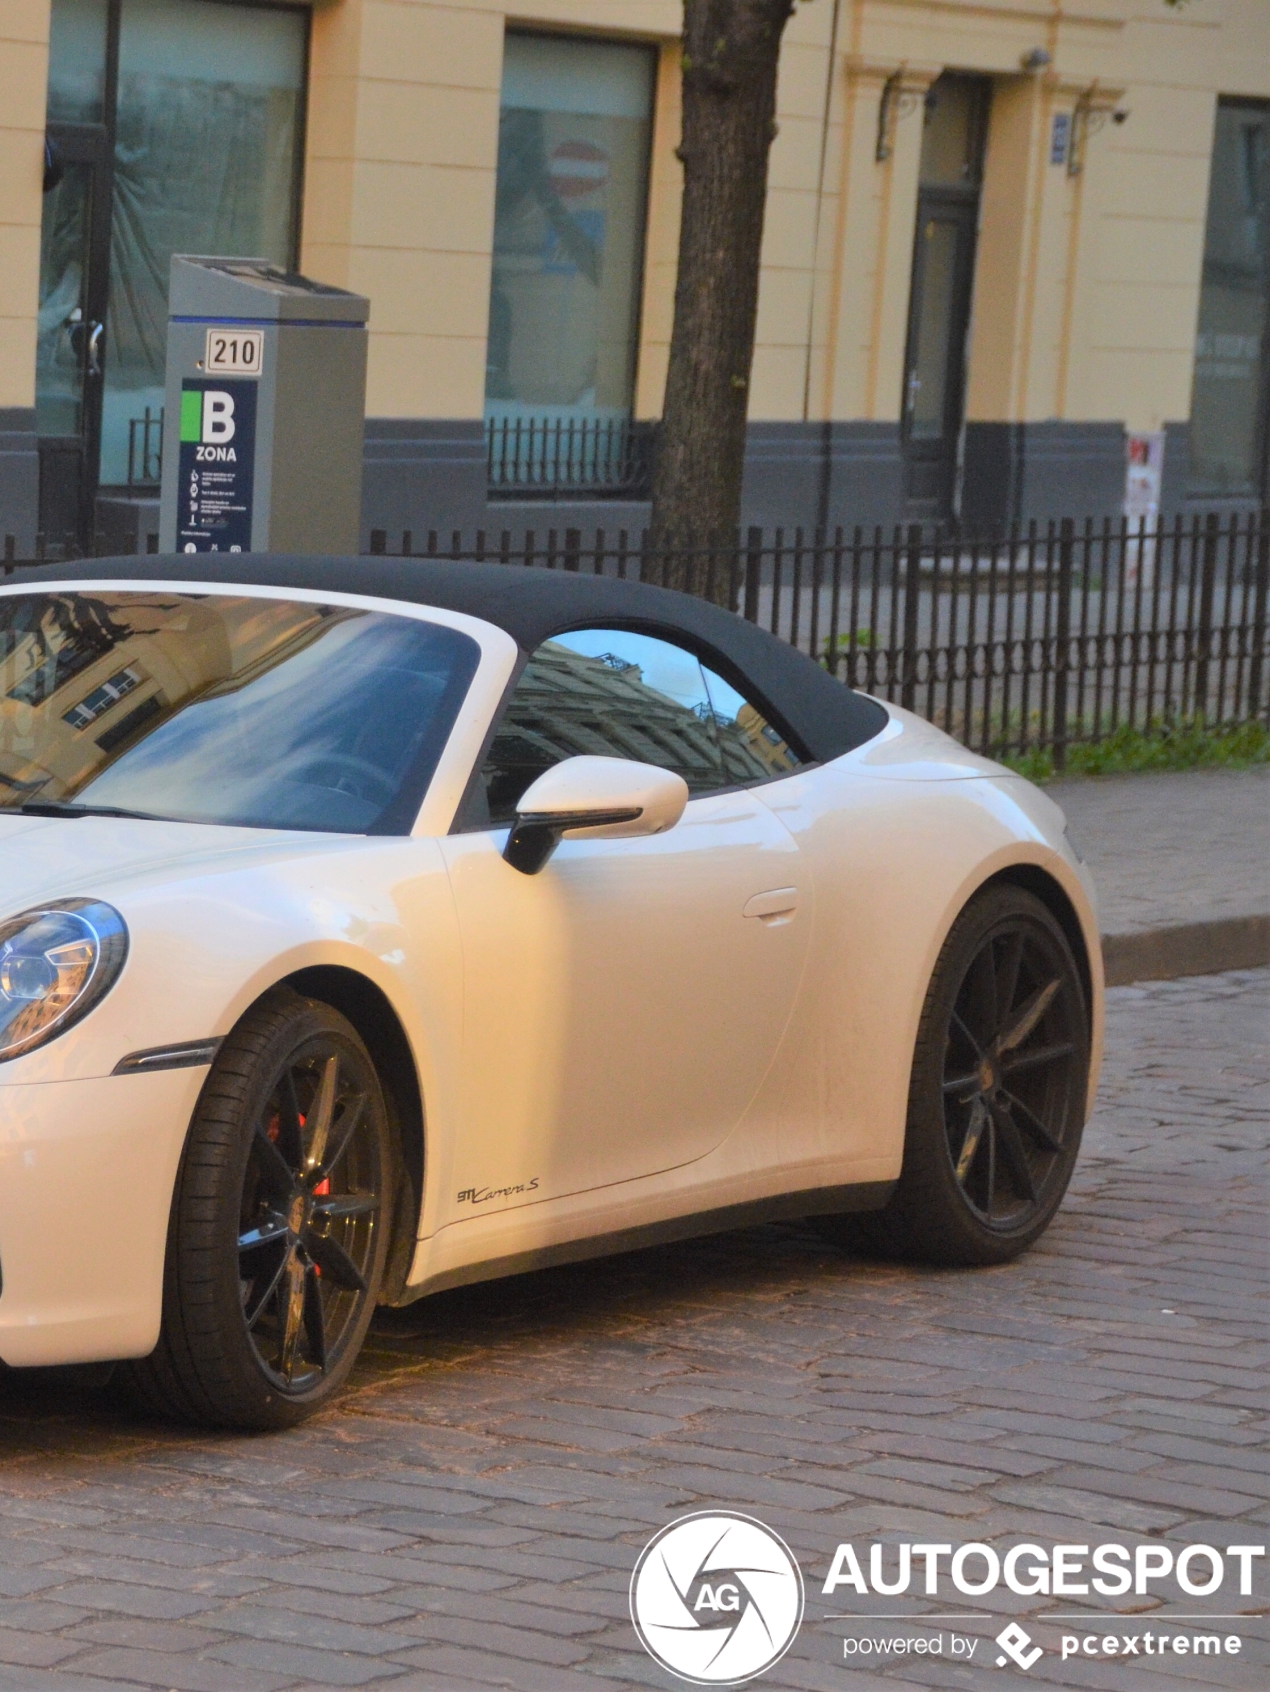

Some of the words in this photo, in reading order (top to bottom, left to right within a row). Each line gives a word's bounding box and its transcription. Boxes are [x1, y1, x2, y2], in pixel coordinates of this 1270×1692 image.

[214, 339, 255, 365] 210
[202, 391, 236, 444] B
[196, 447, 237, 462] ZONA
[471, 1184, 525, 1204] Carrera
[526, 1177, 539, 1191] S
